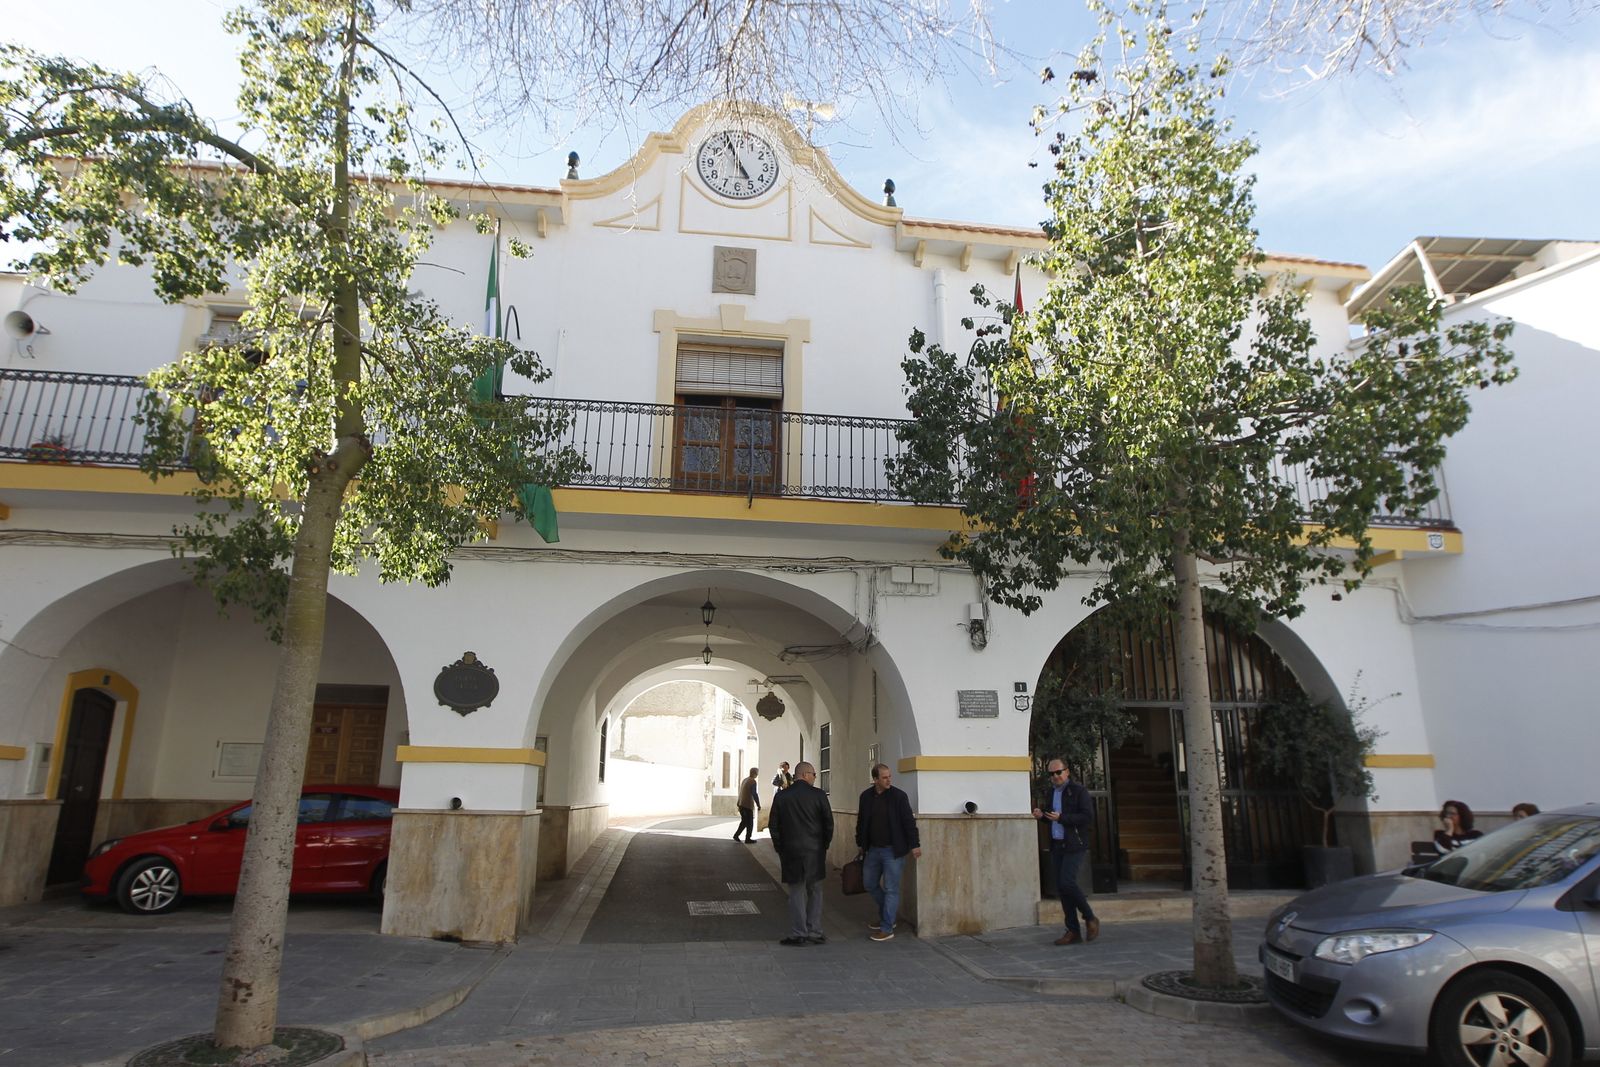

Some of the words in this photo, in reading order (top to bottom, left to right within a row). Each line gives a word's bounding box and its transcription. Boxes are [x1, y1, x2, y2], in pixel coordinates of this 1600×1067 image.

[712, 147, 723, 157] 10
[749, 142, 754, 152] 1
[758, 151, 765, 161] 2
[707, 158, 714, 168] 9
[762, 163, 769, 173] 3
[711, 169, 718, 180] 8
[757, 173, 765, 183] 4
[722, 178, 729, 188] 7
[734, 182, 741, 192] 6
[747, 180, 754, 190] 5
